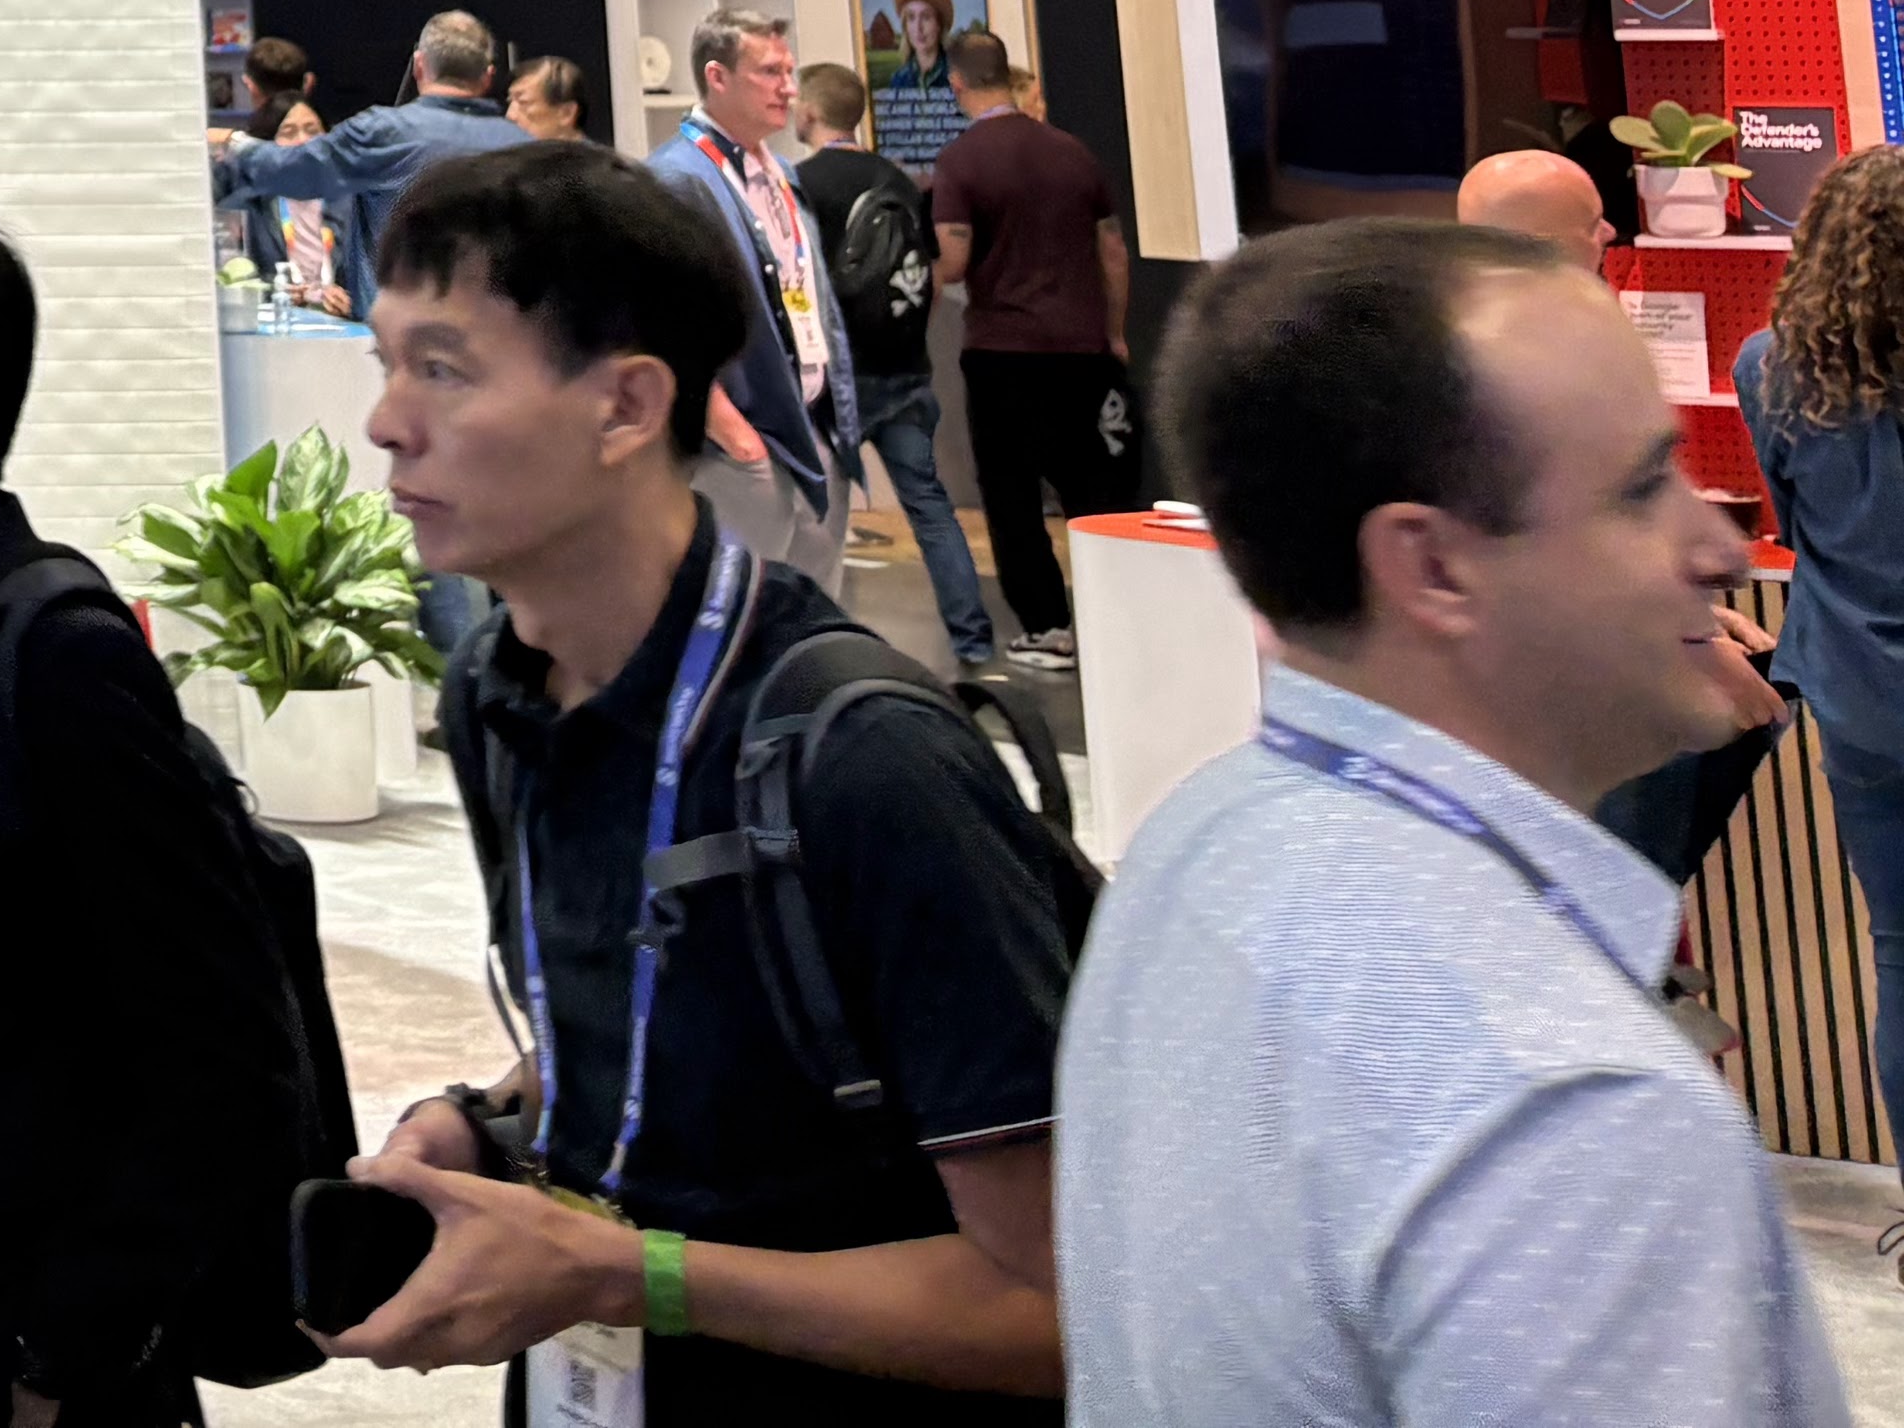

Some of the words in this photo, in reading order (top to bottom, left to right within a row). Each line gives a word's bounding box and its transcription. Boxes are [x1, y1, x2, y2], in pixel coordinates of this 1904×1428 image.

[1739, 111, 1768, 125] The
[1739, 123, 1820, 137] Defender's
[1741, 135, 1823, 151] Advantage
